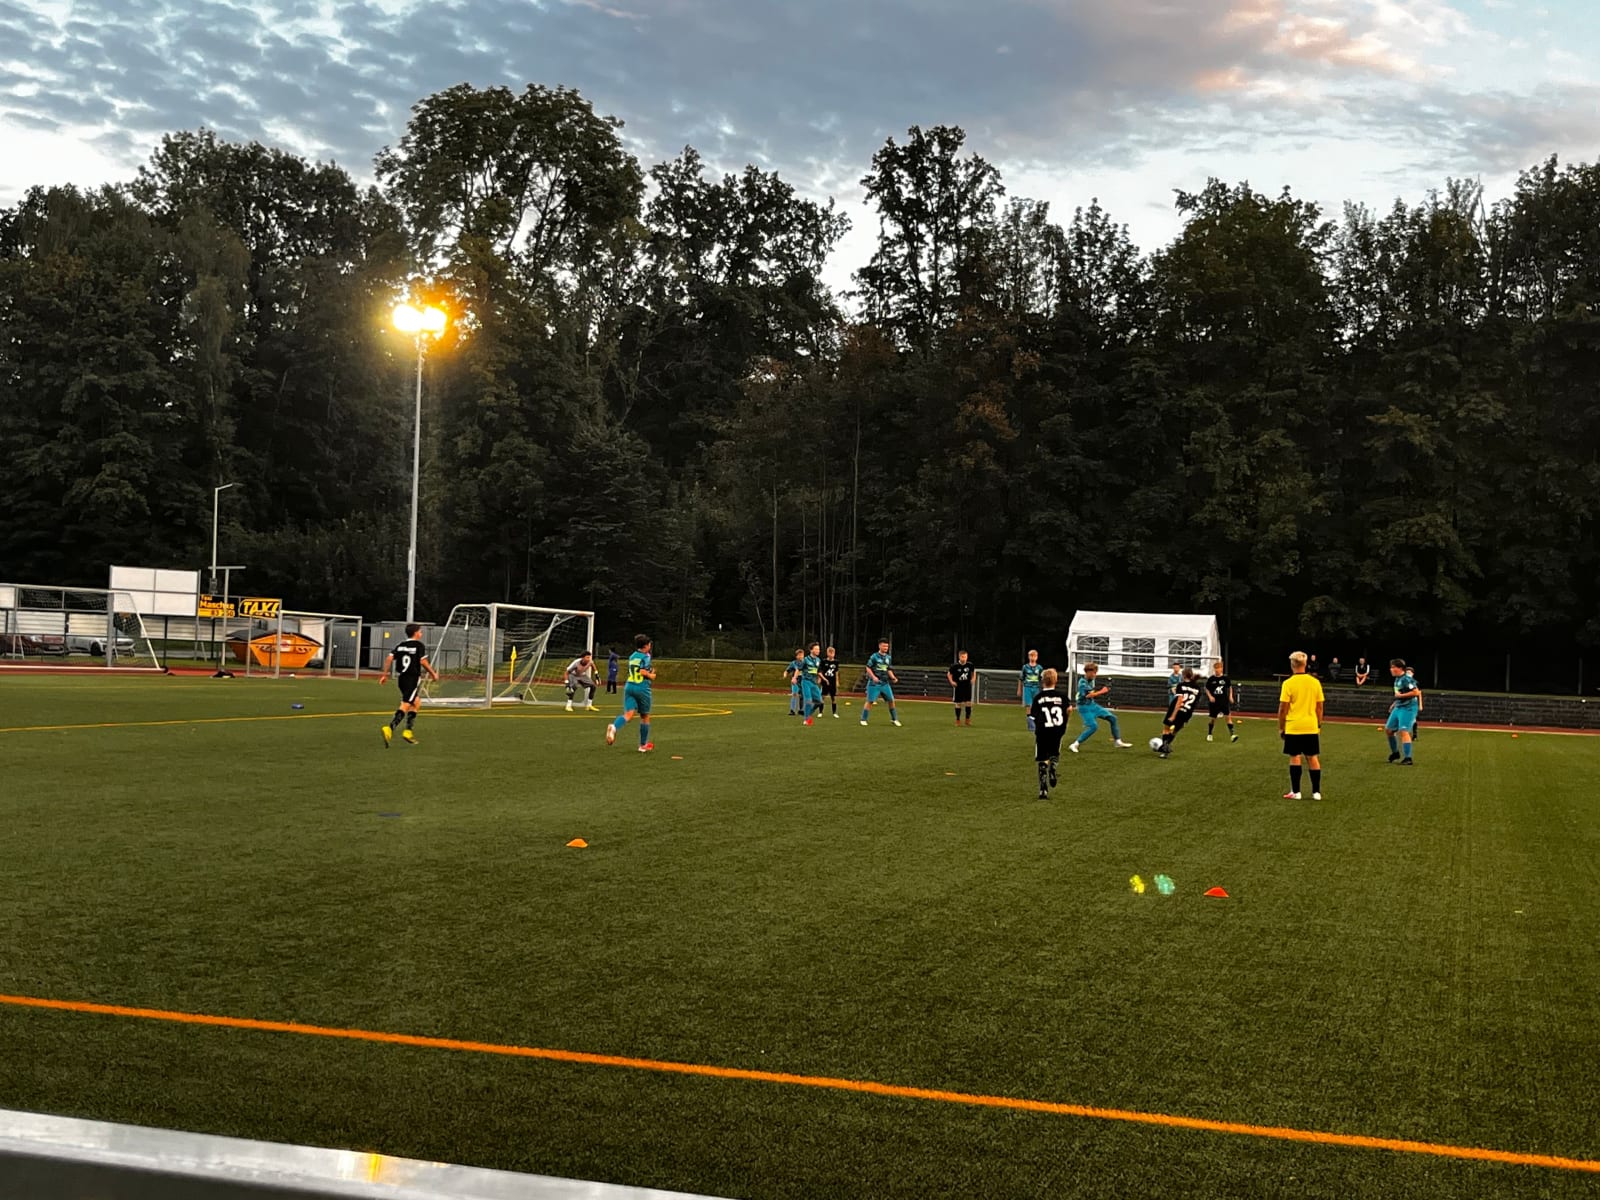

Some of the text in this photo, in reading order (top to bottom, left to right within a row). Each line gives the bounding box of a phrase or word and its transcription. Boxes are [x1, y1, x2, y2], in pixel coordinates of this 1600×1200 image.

[243, 602, 279, 617] TAXI
[402, 655, 411, 673] 9
[1041, 706, 1064, 728] 13
